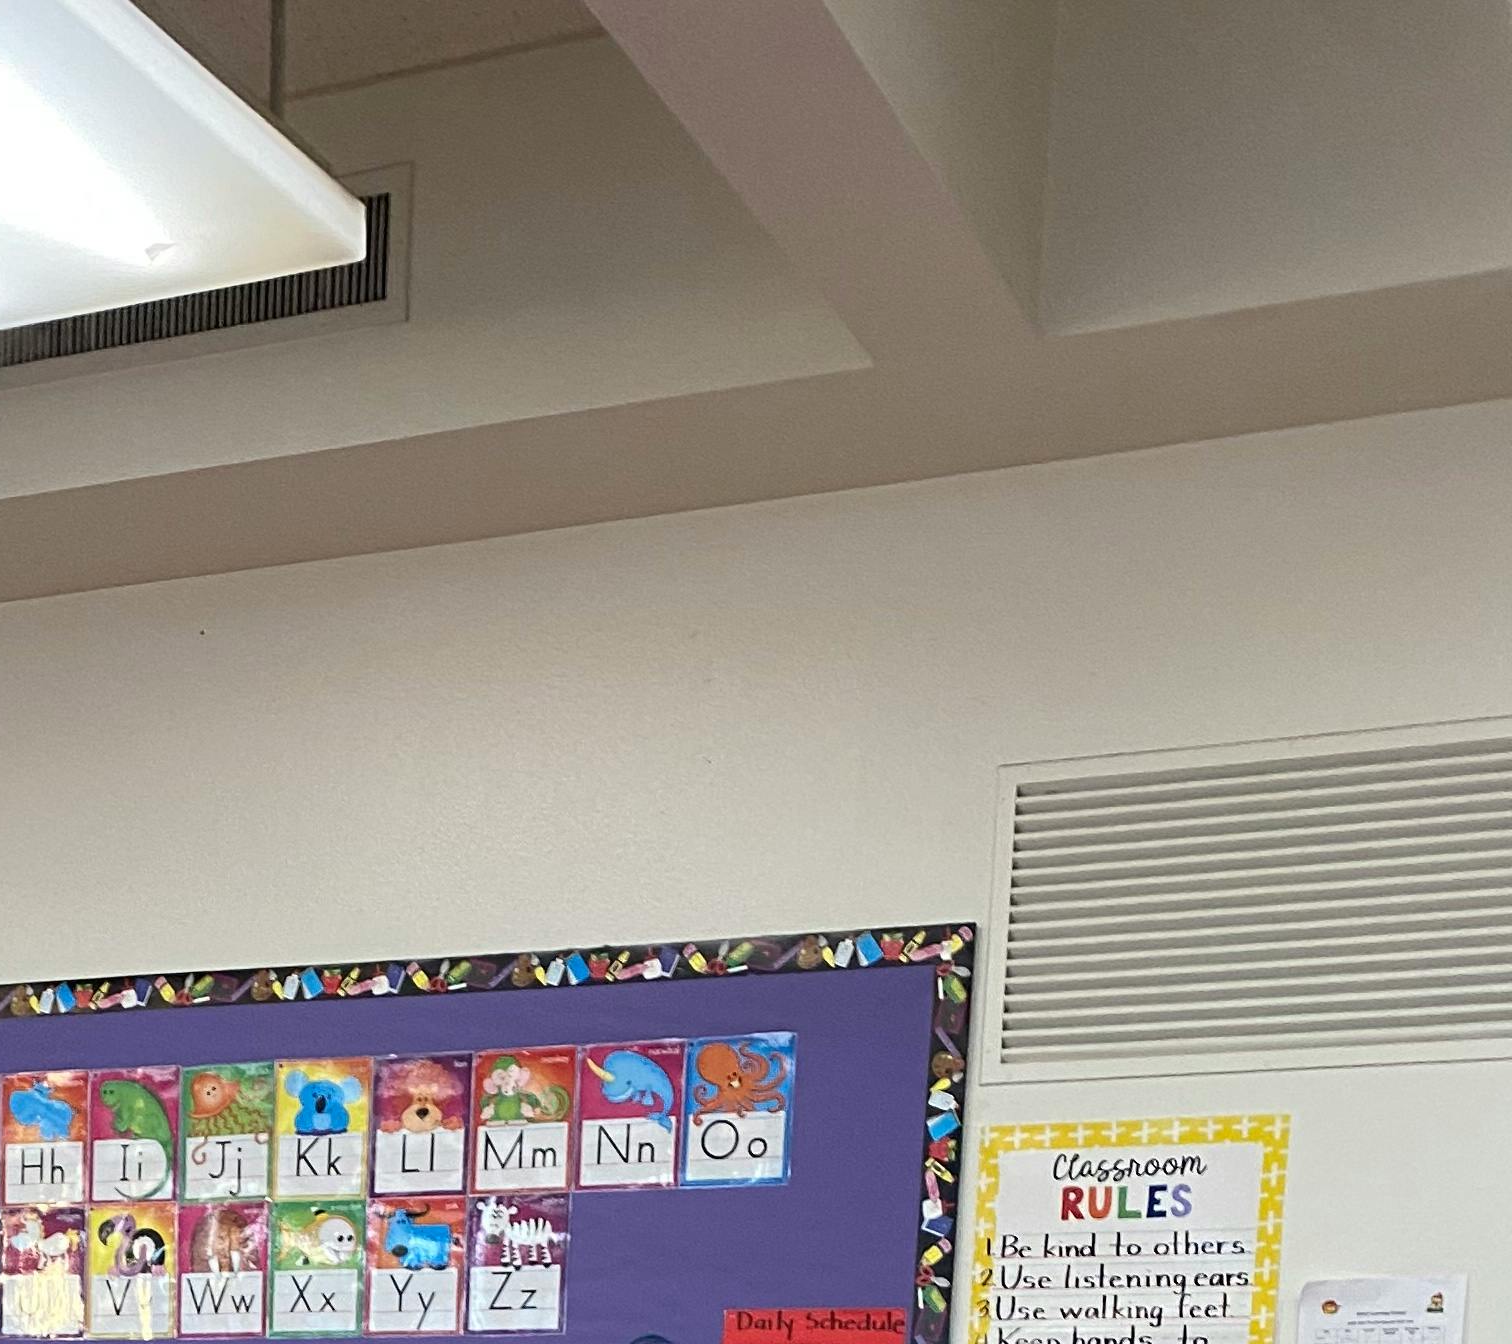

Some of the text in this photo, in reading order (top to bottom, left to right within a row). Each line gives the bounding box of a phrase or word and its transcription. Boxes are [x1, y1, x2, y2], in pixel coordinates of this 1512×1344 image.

[296, 1137, 342, 1177] Kk
[401, 1133, 435, 1173] Ll
[484, 1129, 557, 1171] Mm
[597, 1123, 656, 1165] Nn
[700, 1119, 768, 1160] Oo
[20, 1148, 65, 1185] Hh
[119, 1144, 143, 1182] Ii
[208, 1140, 243, 1196] Jj
[1053, 1152, 1209, 1183] Classroom
[1060, 1184, 1192, 1220] RULES
[1000, 1234, 1032, 1258] Be
[1043, 1232, 1096, 1258] kind
[1111, 1231, 1142, 1257] to
[186, 1277, 255, 1314] Ww
[289, 1275, 337, 1313] Xx
[489, 1271, 537, 1310] Zz
[1000, 1265, 1052, 1290] Use
[1064, 1263, 1187, 1295] listening
[389, 1274, 436, 1330] Yy
[995, 1295, 1047, 1321] Use
[1059, 1294, 1164, 1328] walking
[738, 1311, 906, 1341] Daily Schedule
